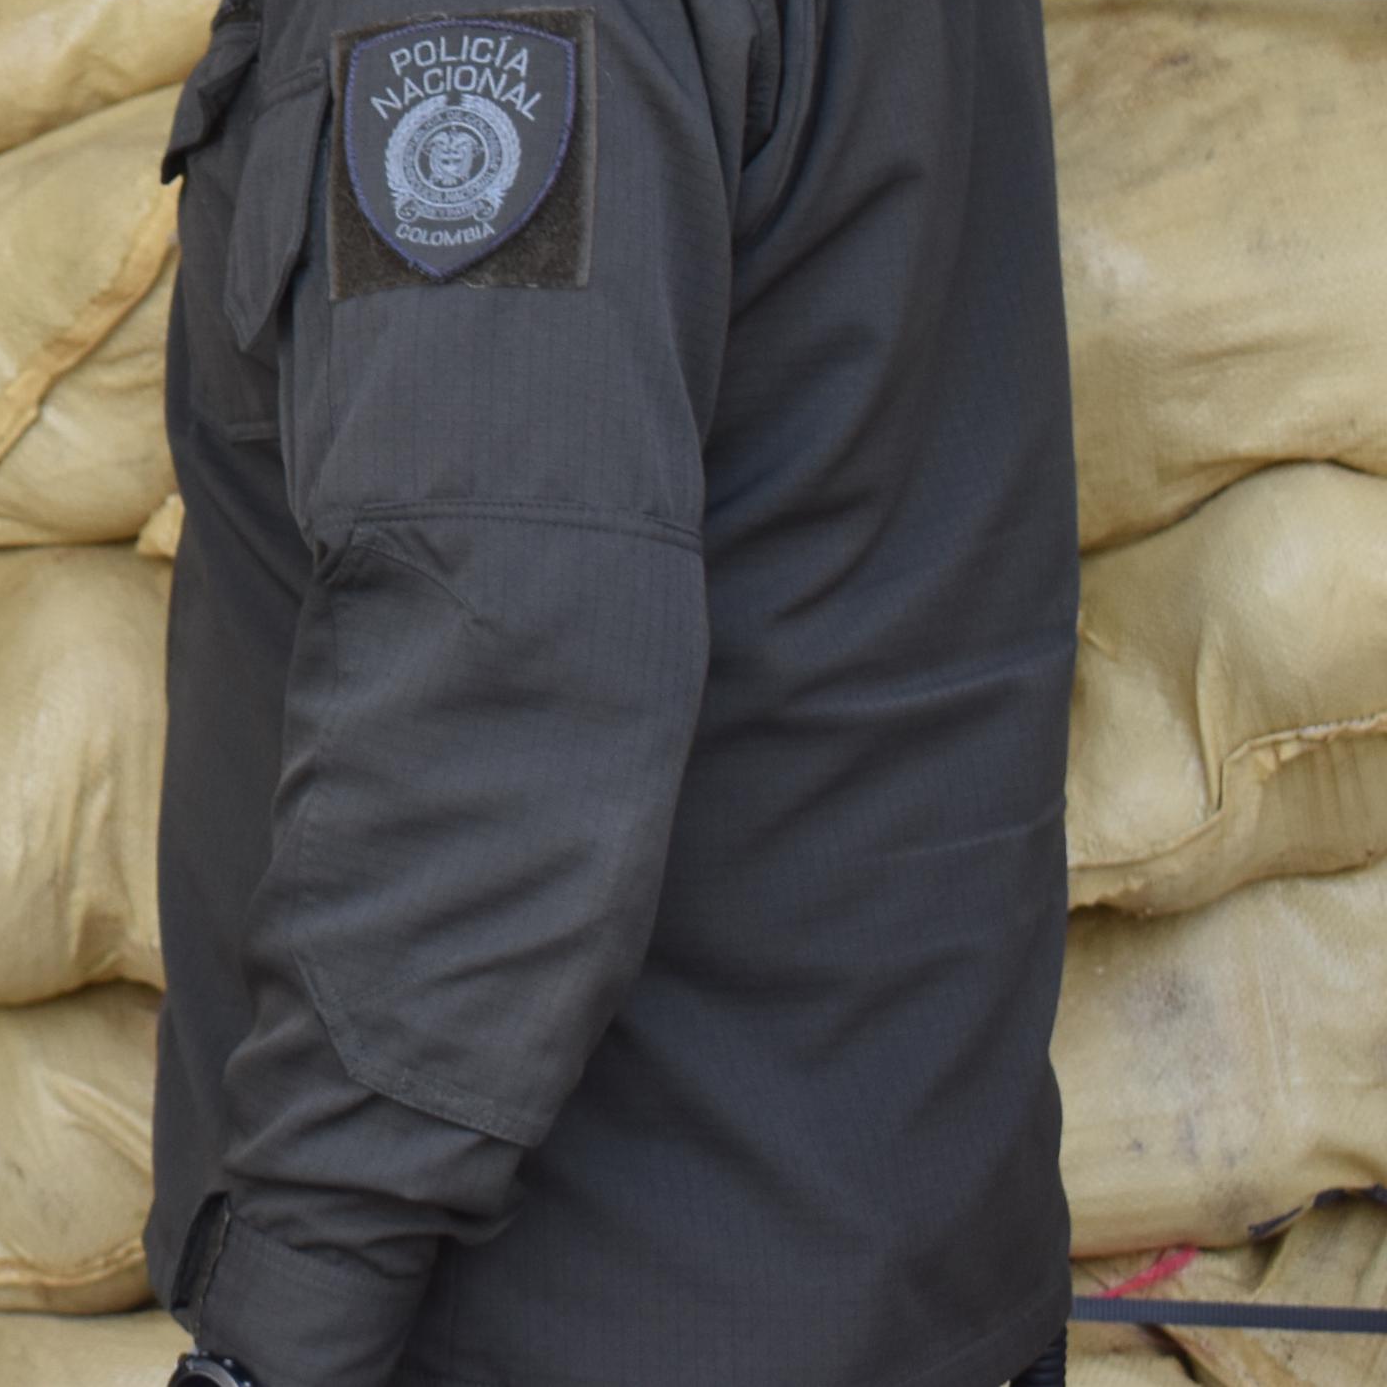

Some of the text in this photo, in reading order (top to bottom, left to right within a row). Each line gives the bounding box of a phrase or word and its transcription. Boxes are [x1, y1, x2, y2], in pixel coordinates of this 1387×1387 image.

[389, 35, 529, 76] POLICÍA
[370, 65, 542, 121] NACIONAL
[395, 222, 495, 246] COLOMBIA
